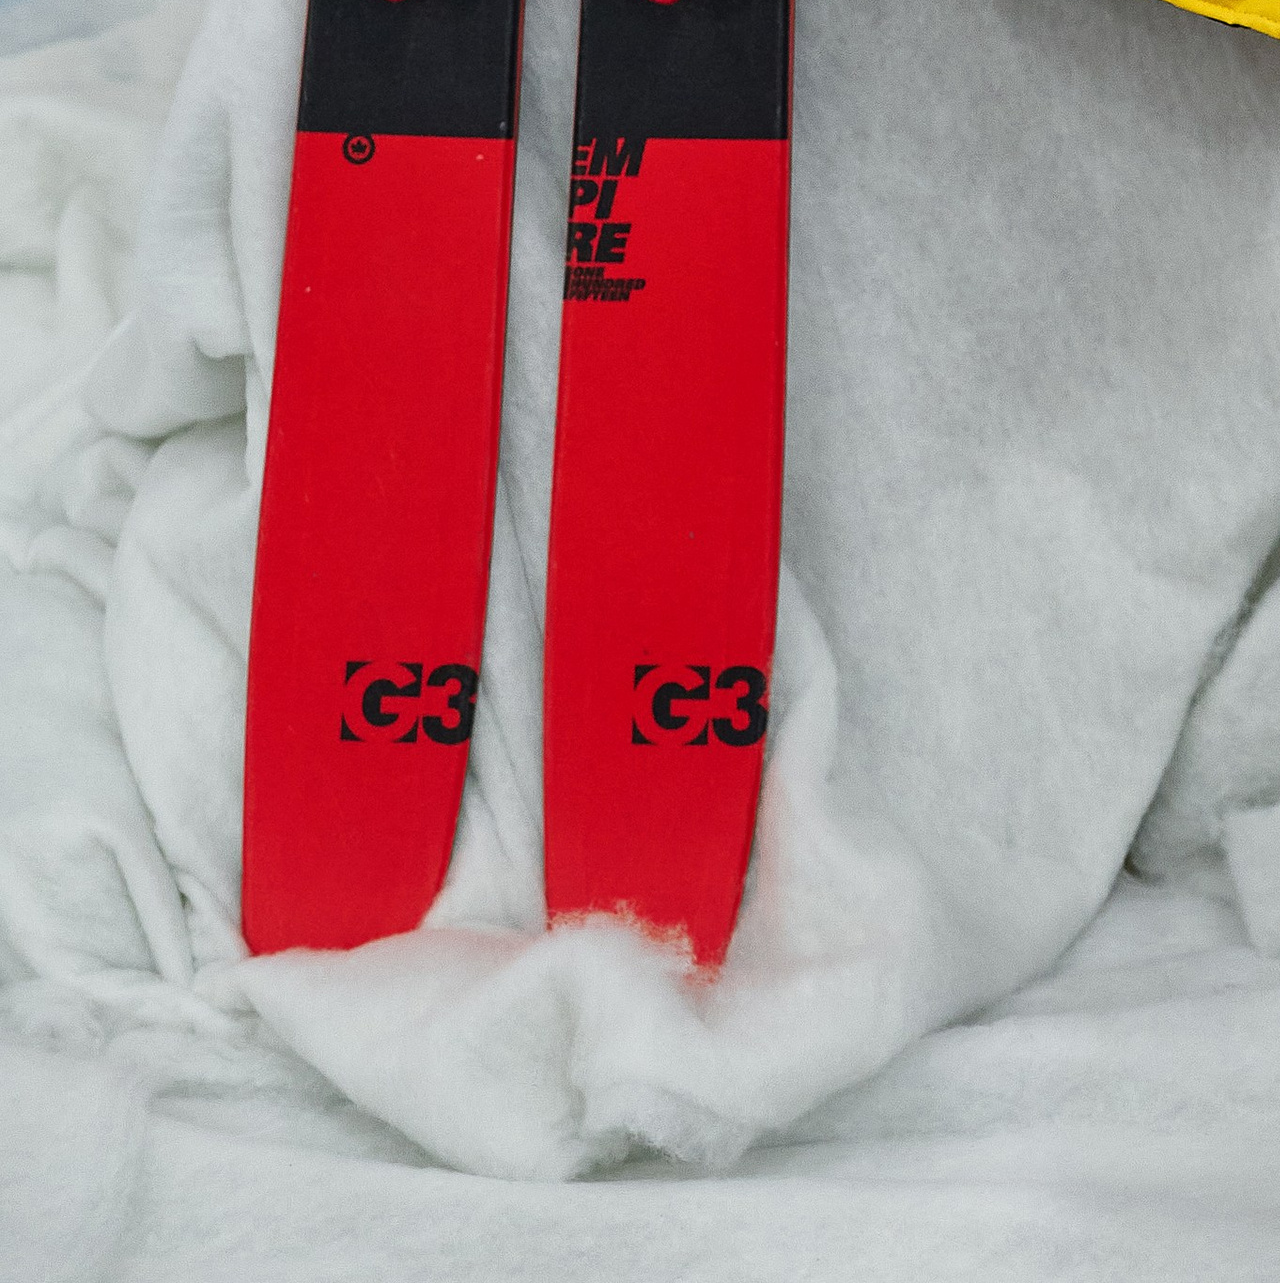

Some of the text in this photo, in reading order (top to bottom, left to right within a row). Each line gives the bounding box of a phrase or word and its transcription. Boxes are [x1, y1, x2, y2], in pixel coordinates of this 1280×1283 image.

[569, 179, 619, 220] PI
[567, 221, 632, 263] RE
[340, 661, 478, 745] G3
[632, 664, 769, 747] G3
